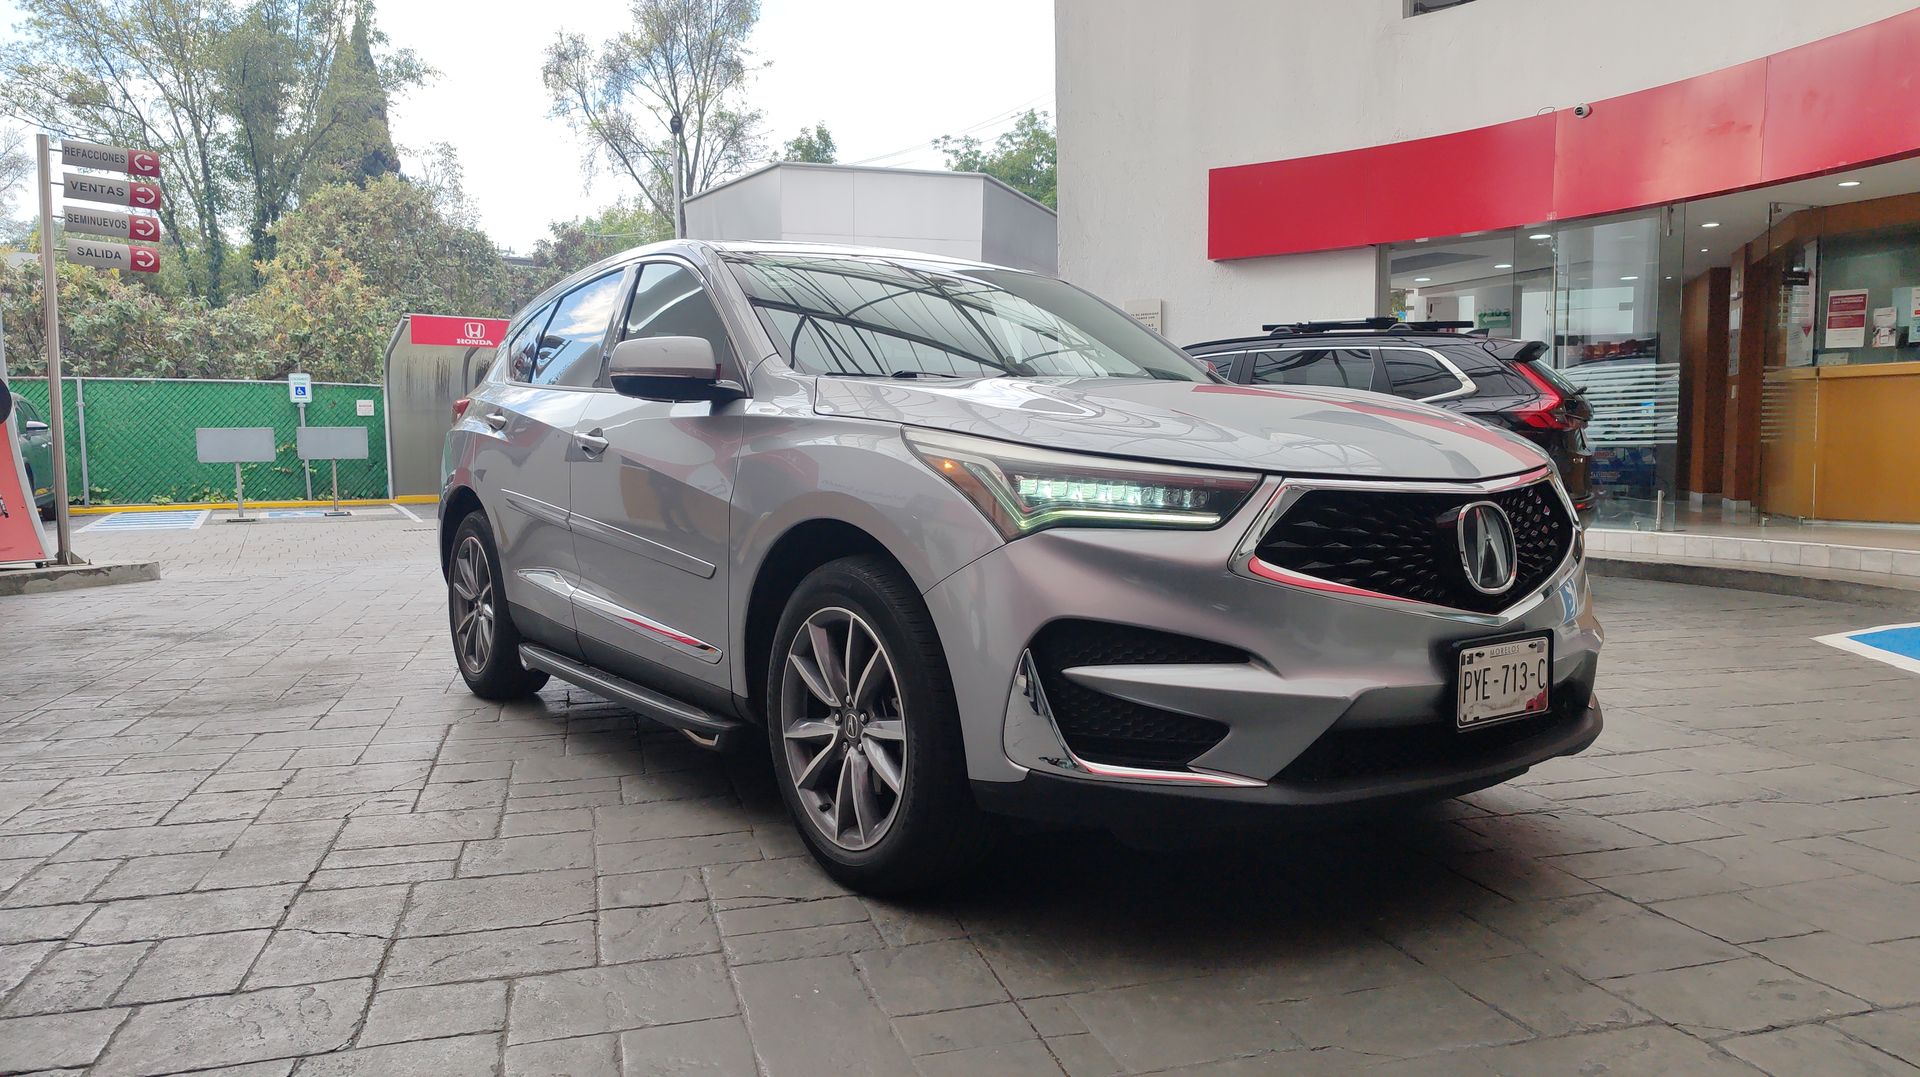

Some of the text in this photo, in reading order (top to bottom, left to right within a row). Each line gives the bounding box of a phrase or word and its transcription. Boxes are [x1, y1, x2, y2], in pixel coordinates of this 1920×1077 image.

[64, 146, 126, 164] REFACCIONES
[70, 180, 125, 197] VENTAS
[67, 213, 127, 230] SEMINUEVOS
[77, 246, 122, 260] SALIDA
[456, 338, 494, 346] HONDA
[1489, 645, 1520, 657] MORELOS
[1462, 658, 1546, 705] PYE-713-C
